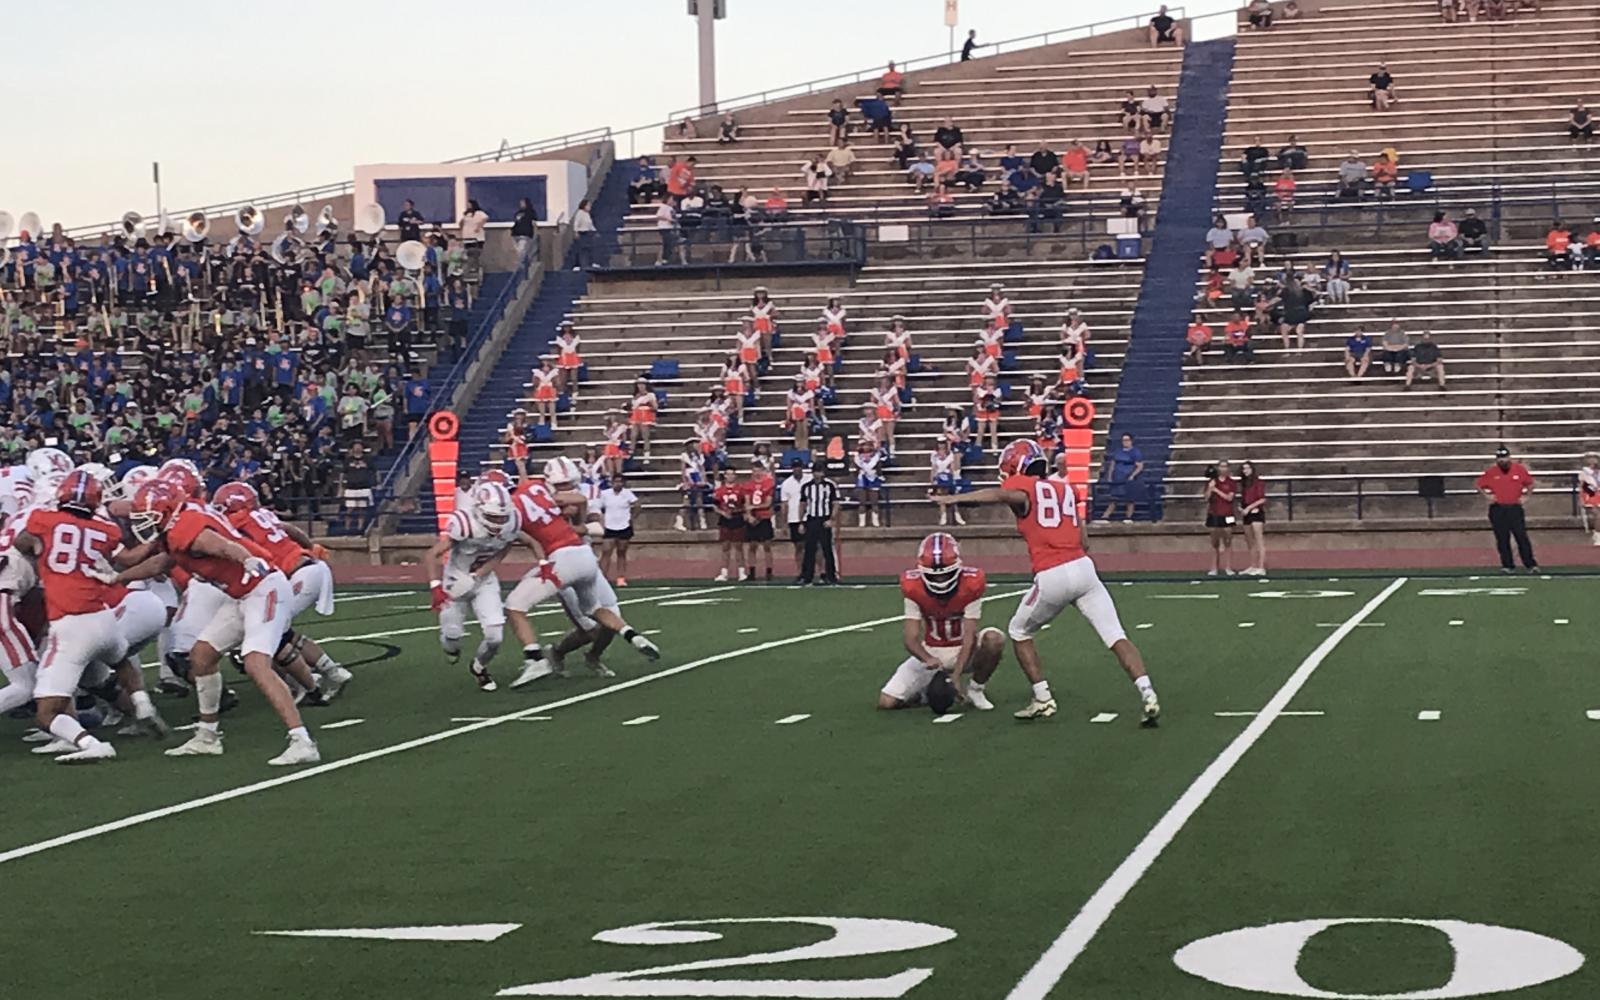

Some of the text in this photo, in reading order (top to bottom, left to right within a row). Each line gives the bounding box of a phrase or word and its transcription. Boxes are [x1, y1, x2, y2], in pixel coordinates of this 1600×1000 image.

[519, 484, 561, 525] 43
[752, 490, 763, 505] 6
[1035, 481, 1078, 527] 84
[47, 523, 107, 577] 85
[928, 615, 965, 641] 10
